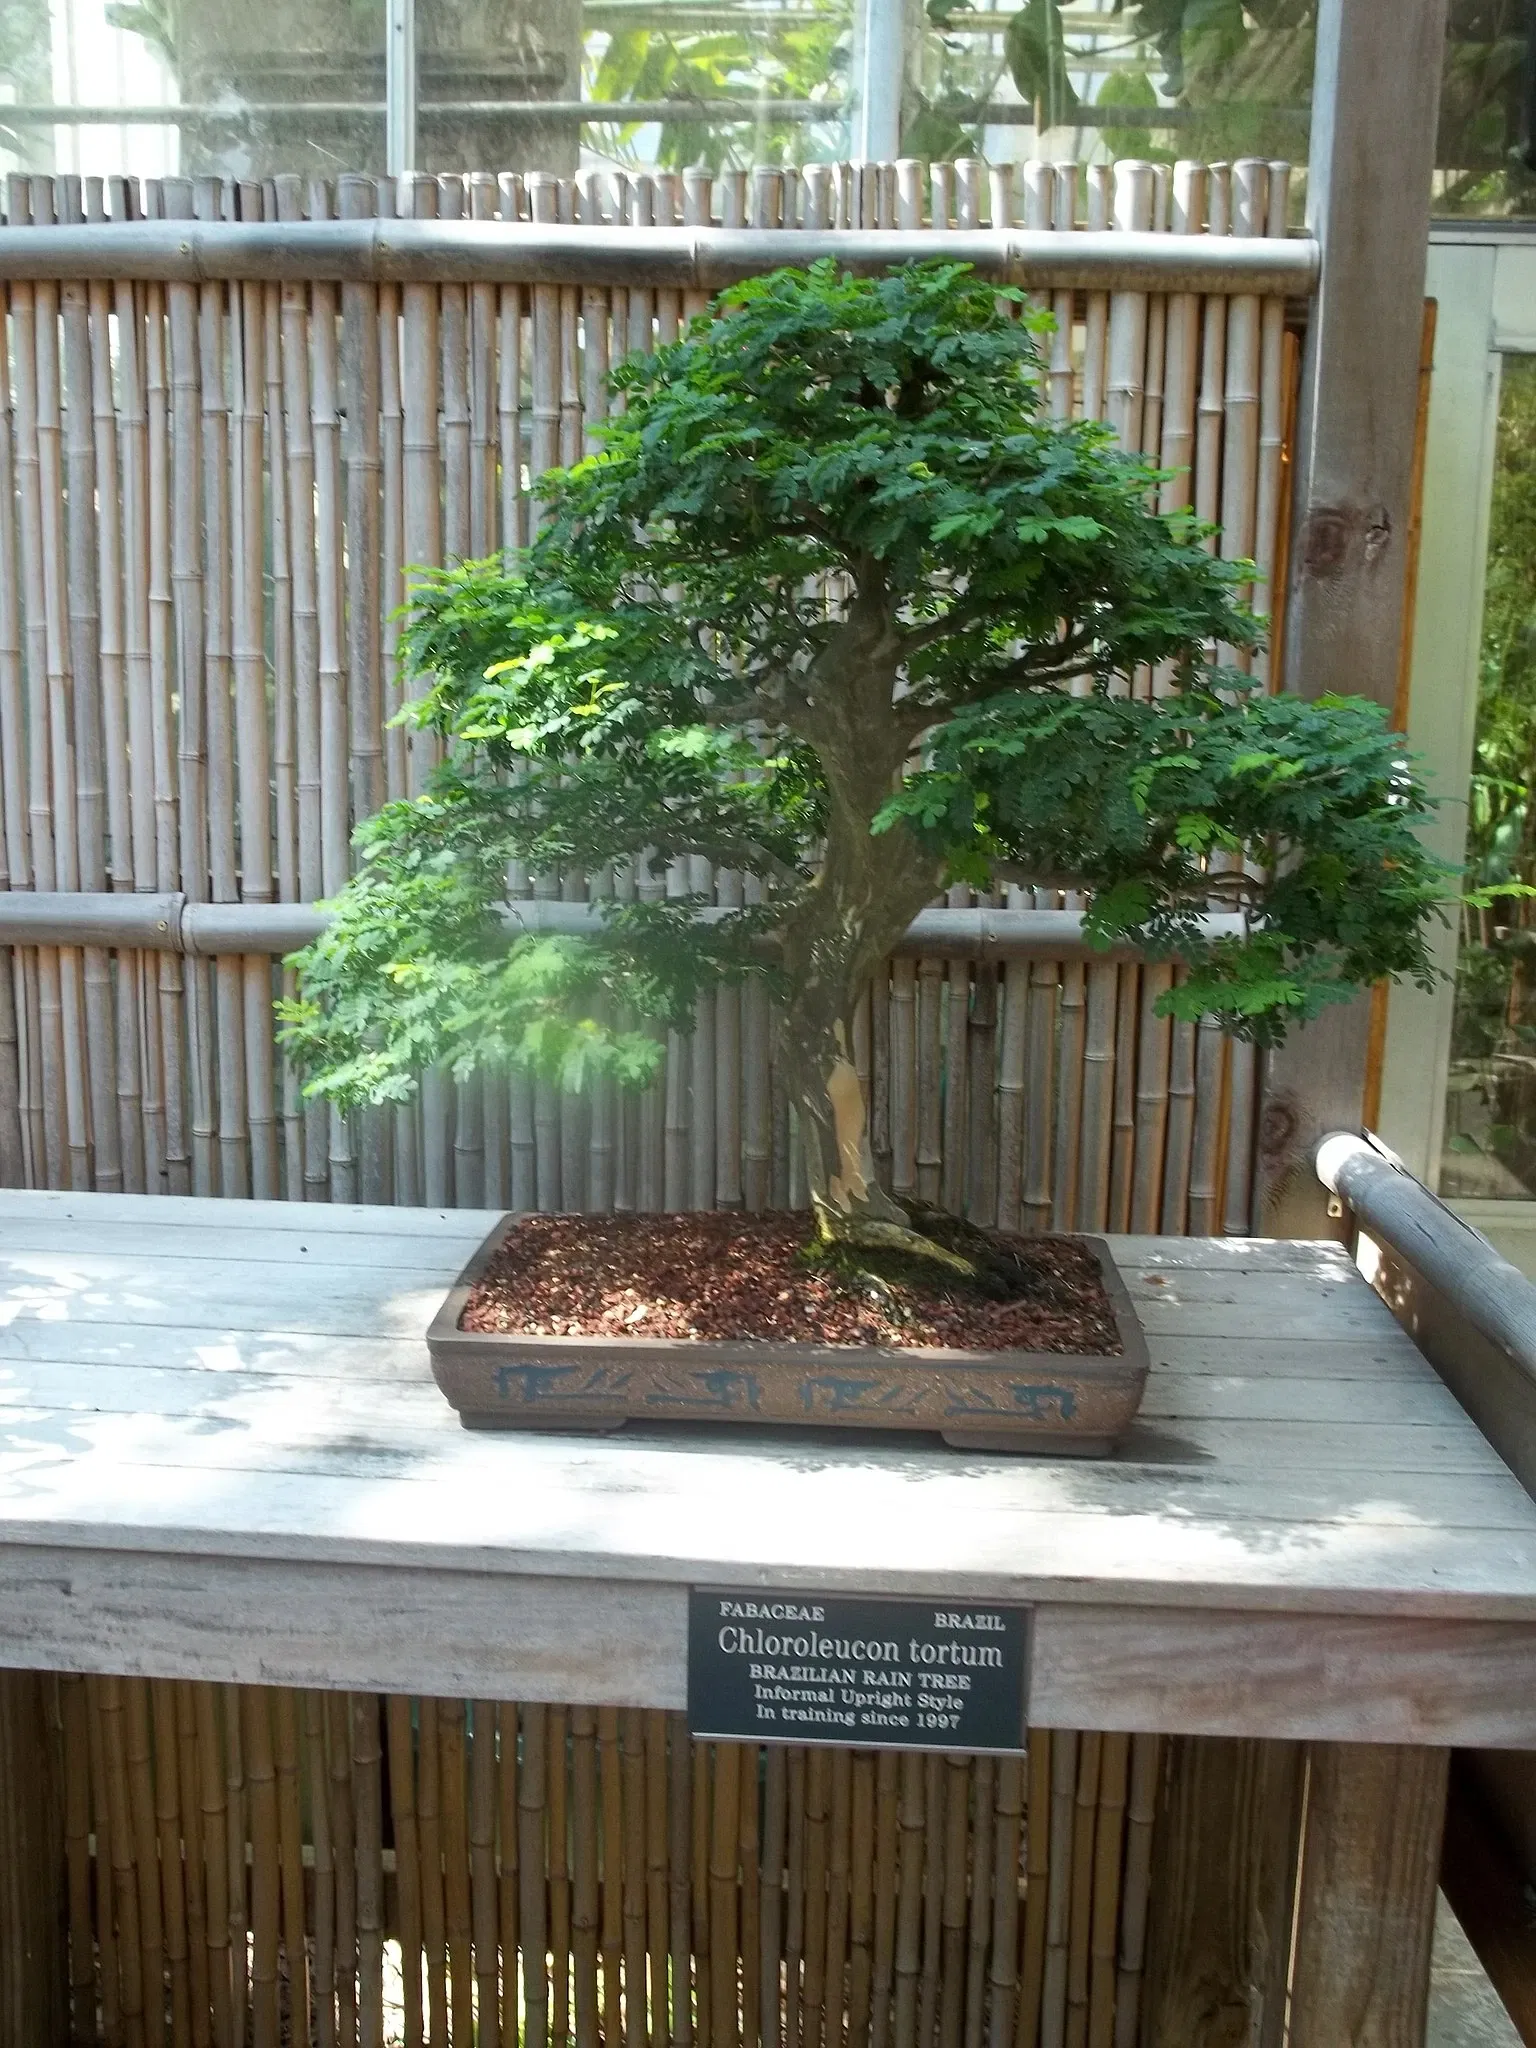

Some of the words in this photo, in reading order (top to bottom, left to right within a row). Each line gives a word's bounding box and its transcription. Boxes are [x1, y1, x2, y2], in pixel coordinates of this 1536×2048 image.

[719, 1601, 825, 1622] FABACEAE
[934, 1612, 1006, 1631] BRAZIL
[718, 1626, 900, 1662] Chloroleucon
[909, 1638, 1004, 1667] tortum
[749, 1664, 856, 1684] BRAZILIAN
[862, 1670, 912, 1688] RAIN
[918, 1672, 971, 1690] TREE
[753, 1684, 835, 1703] Informal
[841, 1689, 912, 1710] Upright
[917, 1693, 964, 1712] Style
[756, 1704, 776, 1720] In
[781, 1706, 856, 1727] training
[861, 1709, 910, 1727] since
[916, 1712, 961, 1729] 1997
